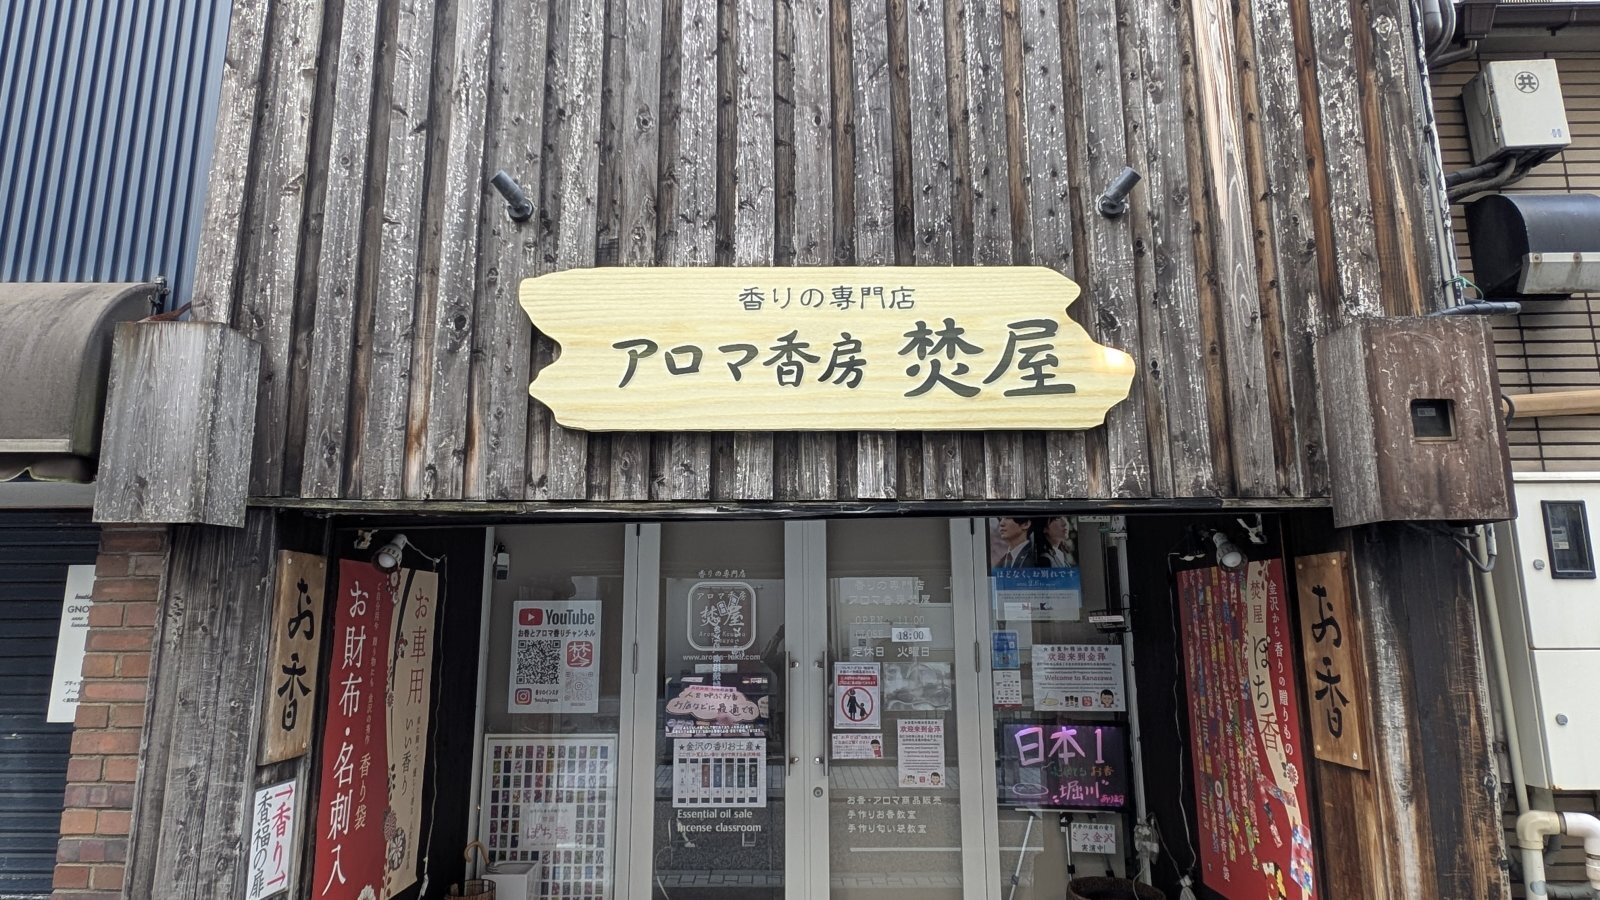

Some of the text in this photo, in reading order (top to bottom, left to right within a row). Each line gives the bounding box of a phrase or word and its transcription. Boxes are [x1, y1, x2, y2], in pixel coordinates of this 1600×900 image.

[738, 286, 916, 310] 香りの専門店
[612, 317, 1076, 398] アロマ香房 焚屋
[698, 569, 747, 578] 香りの専門店
[1250, 581, 1264, 625] 焚屋
[545, 609, 595, 625] YouTube
[518, 629, 596, 638] お香とアロマ香りチャンネル
[897, 630, 925, 640] 18:00
[277, 577, 315, 732] お香
[852, 646, 931, 658] 定休日 火曜日
[1312, 584, 1350, 739] お香
[686, 741, 754, 751] 金沢の香りお土産
[354, 752, 372, 830] 香り袋
[846, 795, 942, 805] お香・アロマ商品販売
[677, 808, 753, 819] Essential oil sale
[847, 809, 917, 819] 手作りお香教室
[677, 823, 762, 832] Incense classroom
